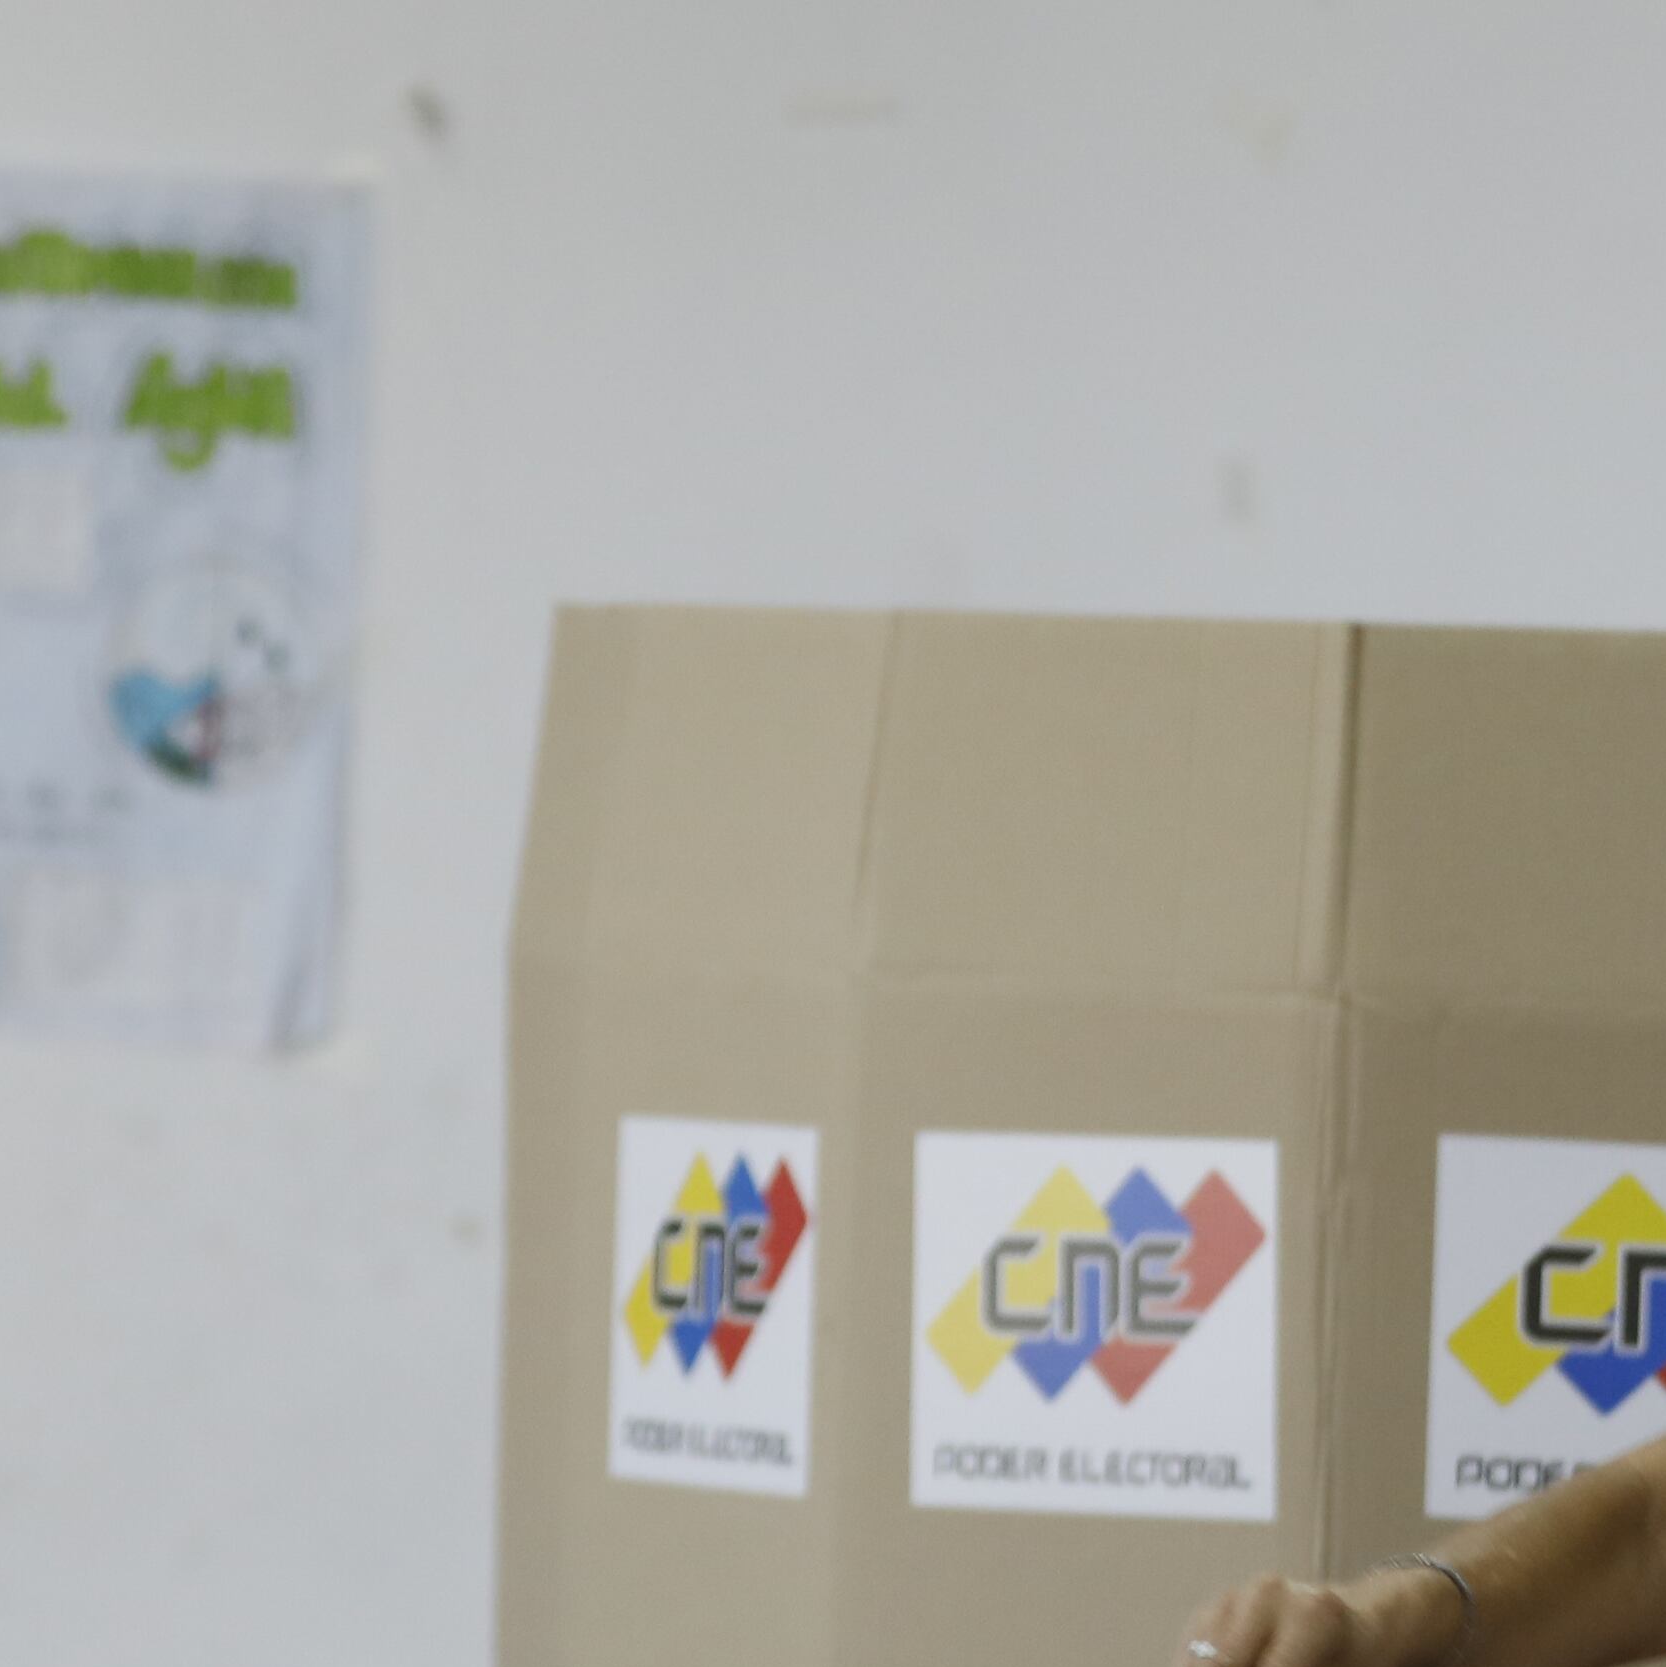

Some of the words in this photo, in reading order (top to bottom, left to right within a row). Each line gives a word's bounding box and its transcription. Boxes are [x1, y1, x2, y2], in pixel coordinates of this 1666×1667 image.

[652, 1218, 765, 1318] CNE
[984, 1237, 1197, 1338] CNE
[933, 1445, 1047, 1479] PODER
